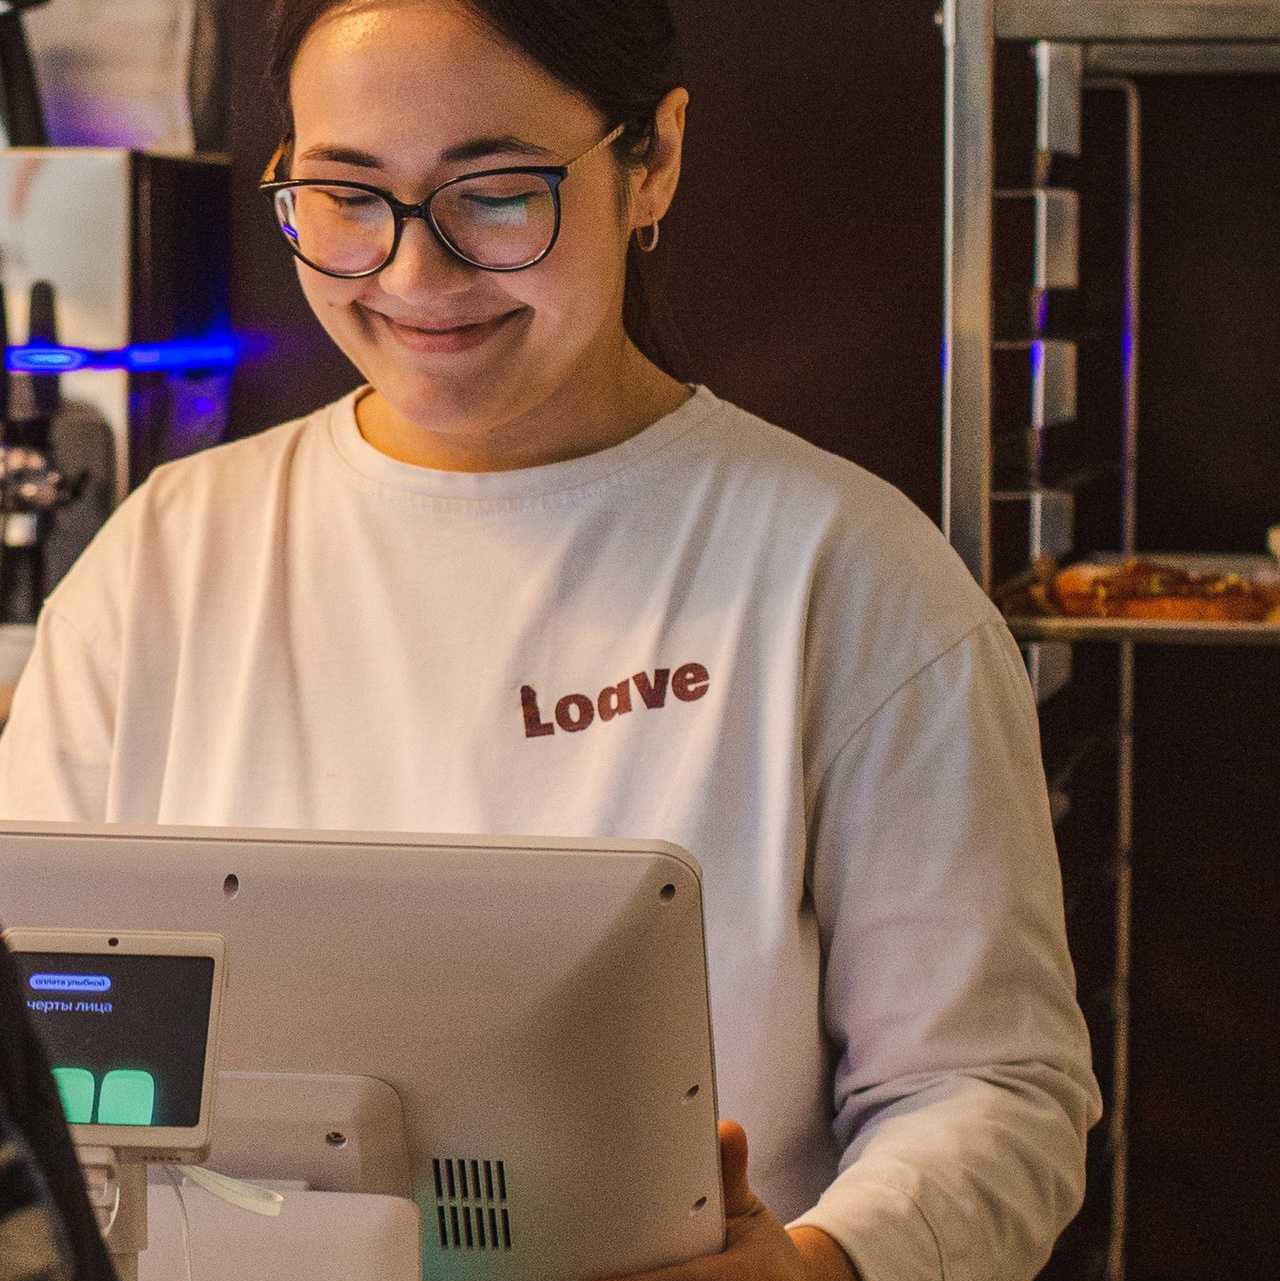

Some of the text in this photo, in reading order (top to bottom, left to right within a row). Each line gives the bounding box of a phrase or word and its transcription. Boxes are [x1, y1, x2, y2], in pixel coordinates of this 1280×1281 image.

[520, 662, 710, 738] Loave
[25, 999, 114, 1014] черты лица
